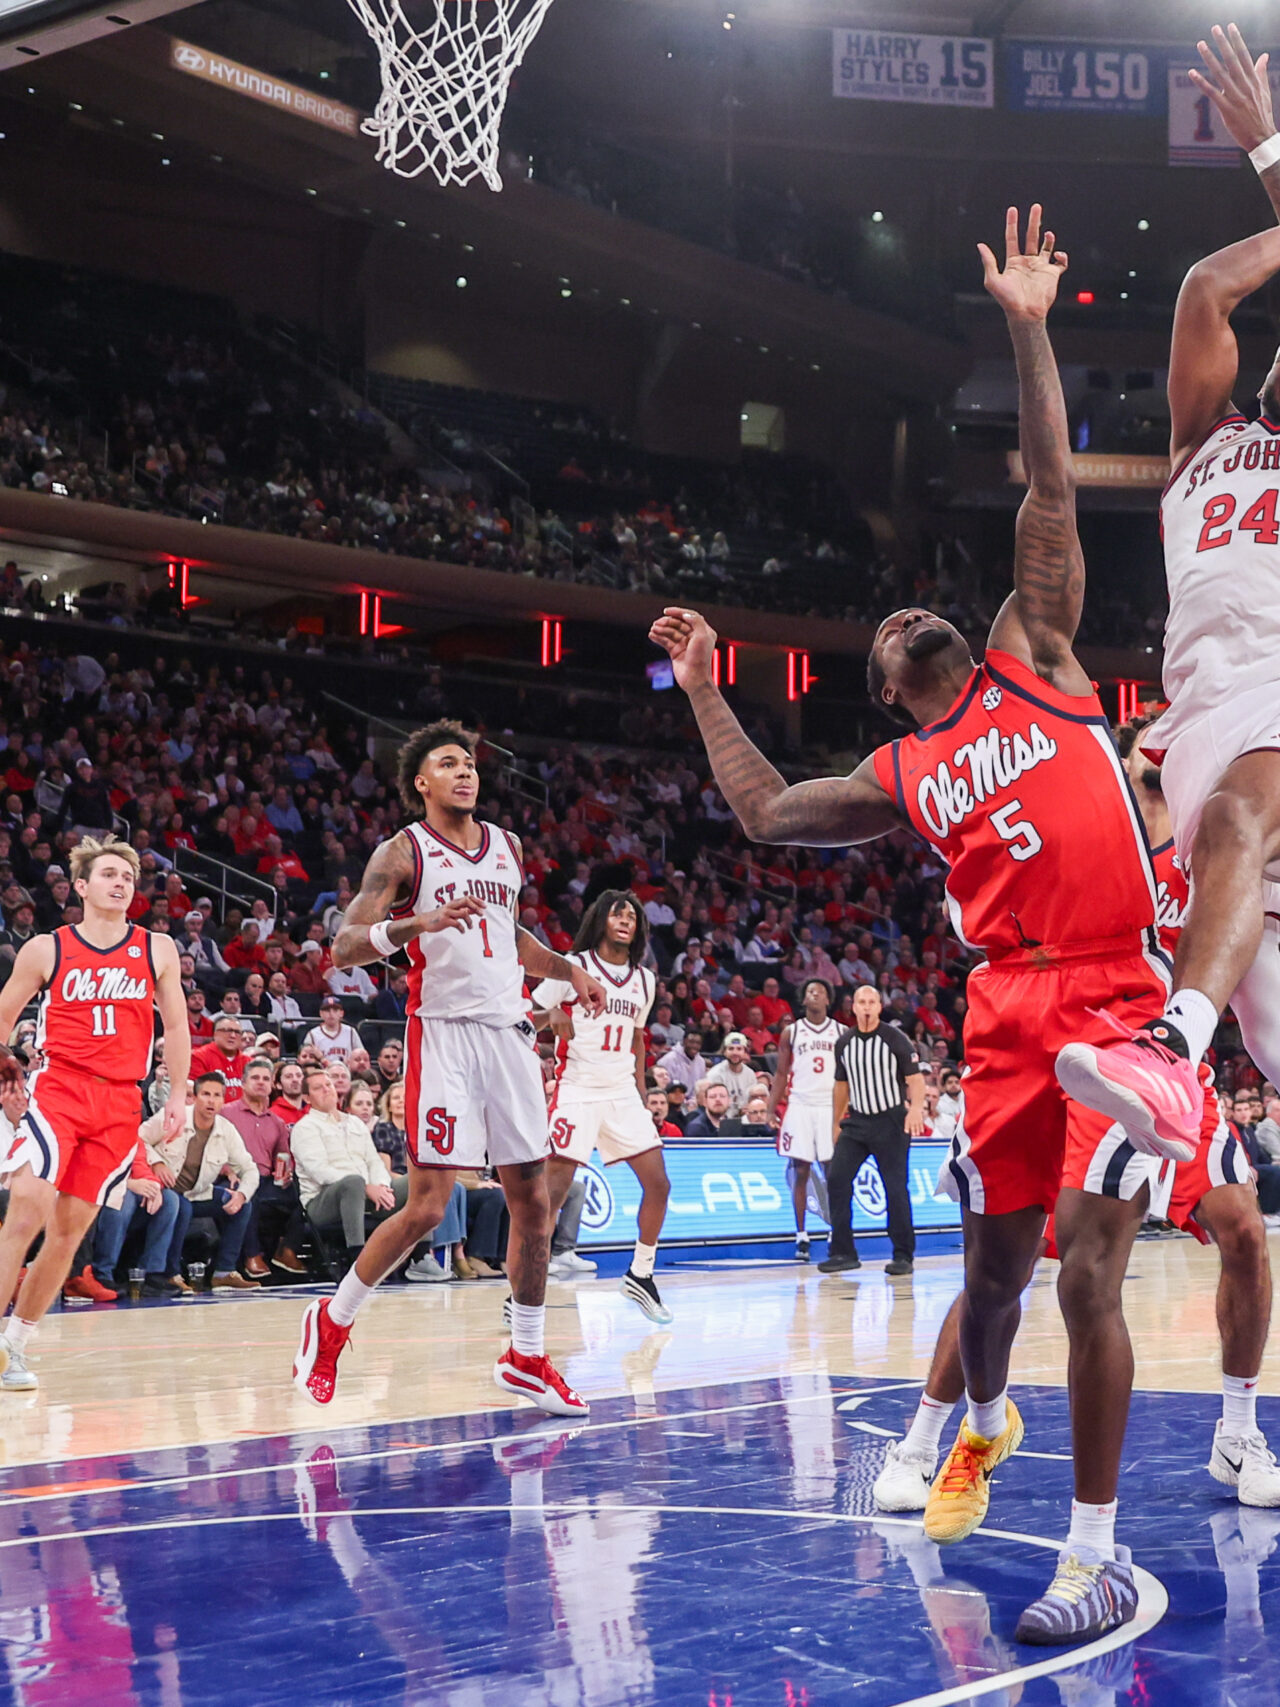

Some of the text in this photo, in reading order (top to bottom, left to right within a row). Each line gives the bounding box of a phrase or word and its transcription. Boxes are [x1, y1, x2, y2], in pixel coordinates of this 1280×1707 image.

[847, 34, 921, 59] HARRY
[940, 41, 987, 88] 15
[1024, 50, 1065, 72] BILLY
[840, 57, 929, 84] STYLES
[1025, 75, 1063, 97] JOEL
[1071, 51, 1149, 100] 150
[209, 59, 356, 129] HYUNDAI BRIDGE
[1193, 94, 1214, 142] 1
[1076, 462, 1125, 479] SUITE
[1183, 454, 1221, 502] ST.
[1196, 488, 1280, 553] 24
[917, 722, 1058, 839] Ole Miss
[988, 799, 1044, 862] 5
[479, 918, 493, 958] 1
[62, 966, 147, 1002] Ole Miss
[90, 1004, 117, 1036] 11
[601, 1024, 624, 1052] 11
[813, 1056, 825, 1074] 3
[426, 1107, 457, 1155] SJ
